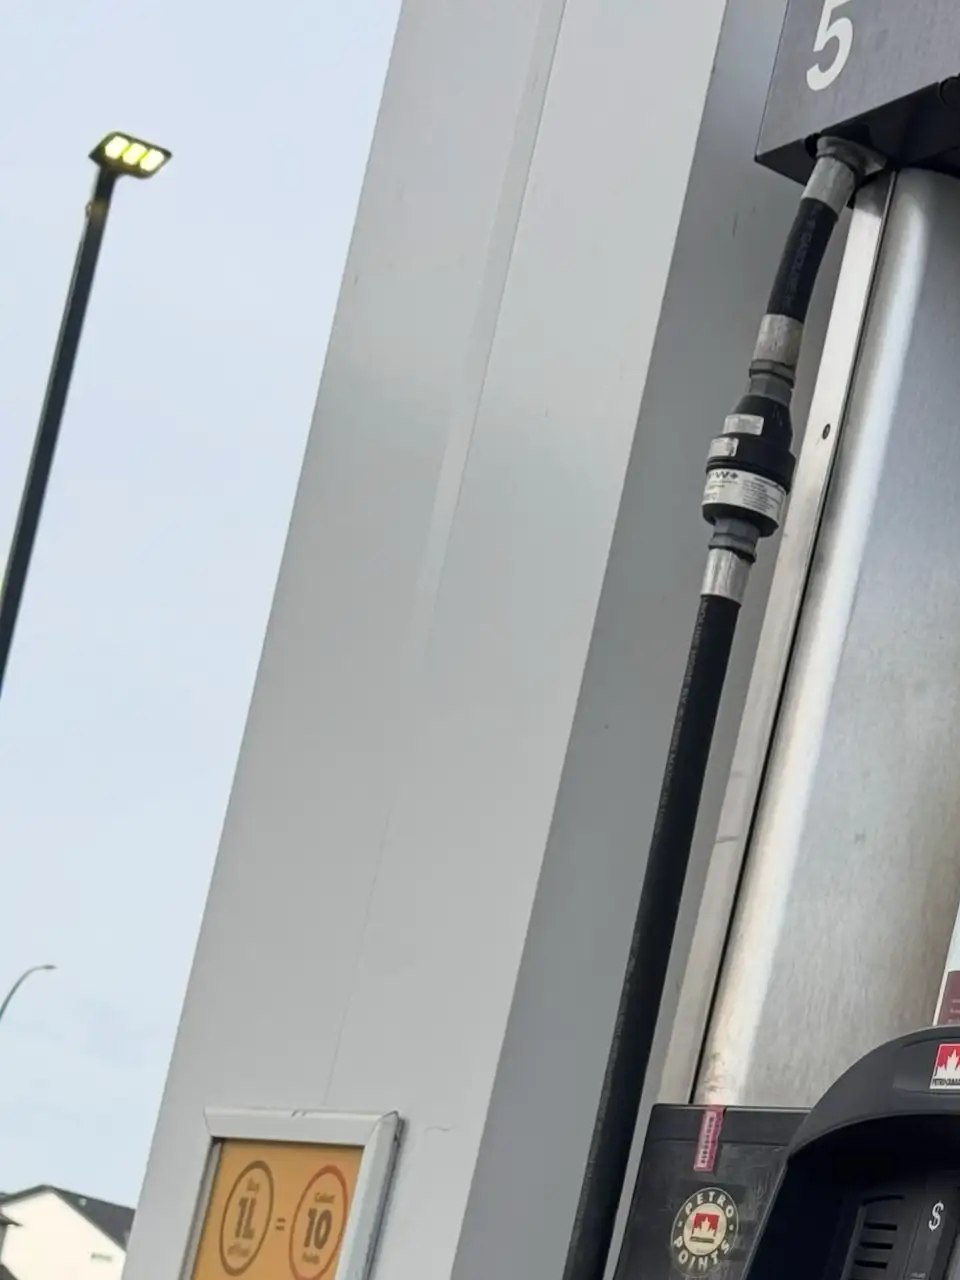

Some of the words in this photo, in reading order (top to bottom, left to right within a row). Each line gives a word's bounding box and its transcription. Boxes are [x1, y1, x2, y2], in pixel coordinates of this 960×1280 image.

[806, 0, 853, 91] 5
[685, 1191, 735, 1218] PETRO
[929, 1200, 944, 1231] $
[304, 1208, 332, 1250] 10
[674, 1235, 730, 1272] POINTS
